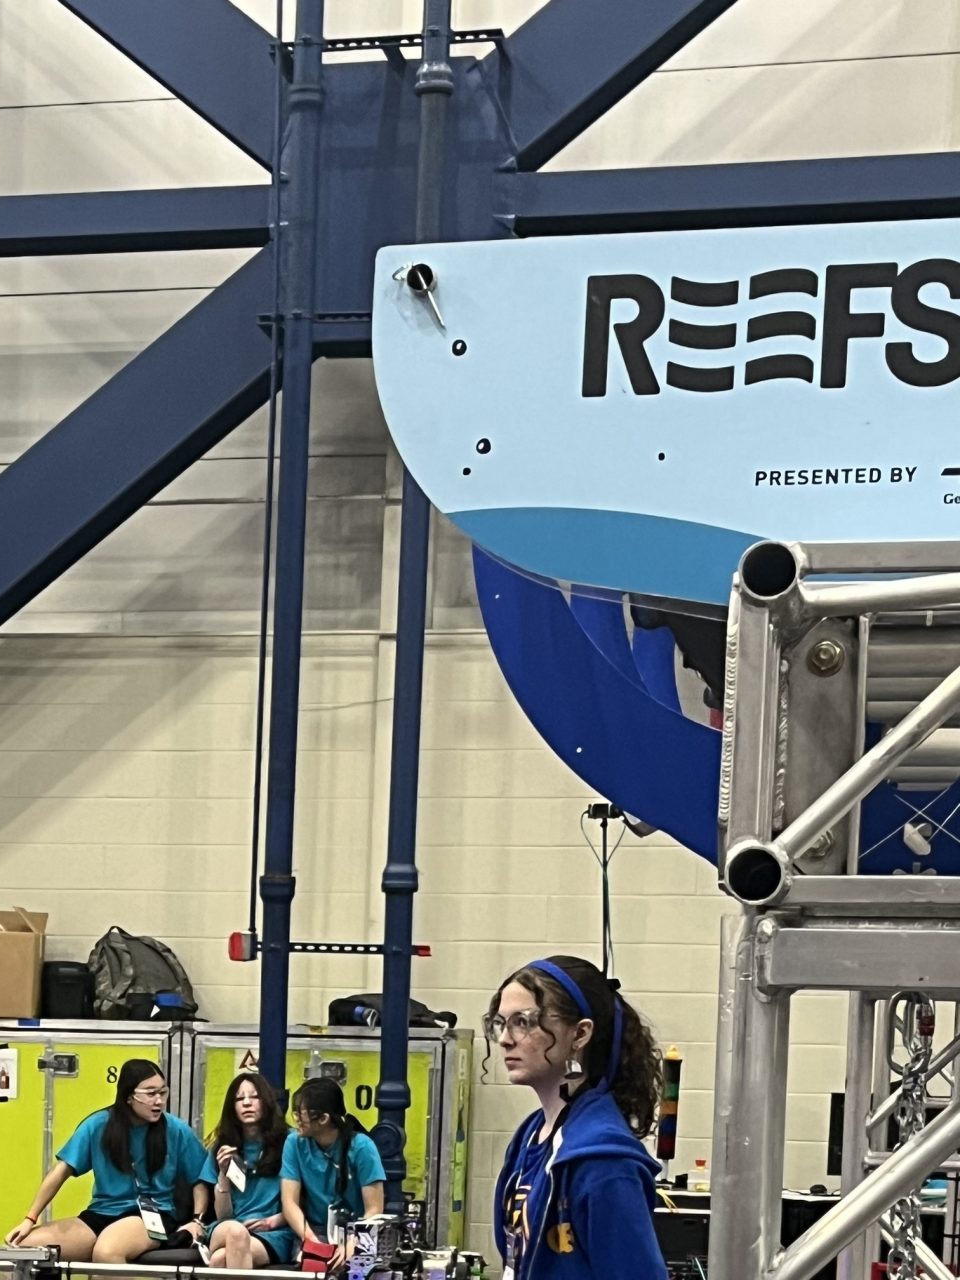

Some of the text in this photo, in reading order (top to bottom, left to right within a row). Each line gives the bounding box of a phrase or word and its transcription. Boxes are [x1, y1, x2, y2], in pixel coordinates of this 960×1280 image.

[582, 258, 960, 397] REEFS
[755, 466, 918, 487] PRESENTED BY
